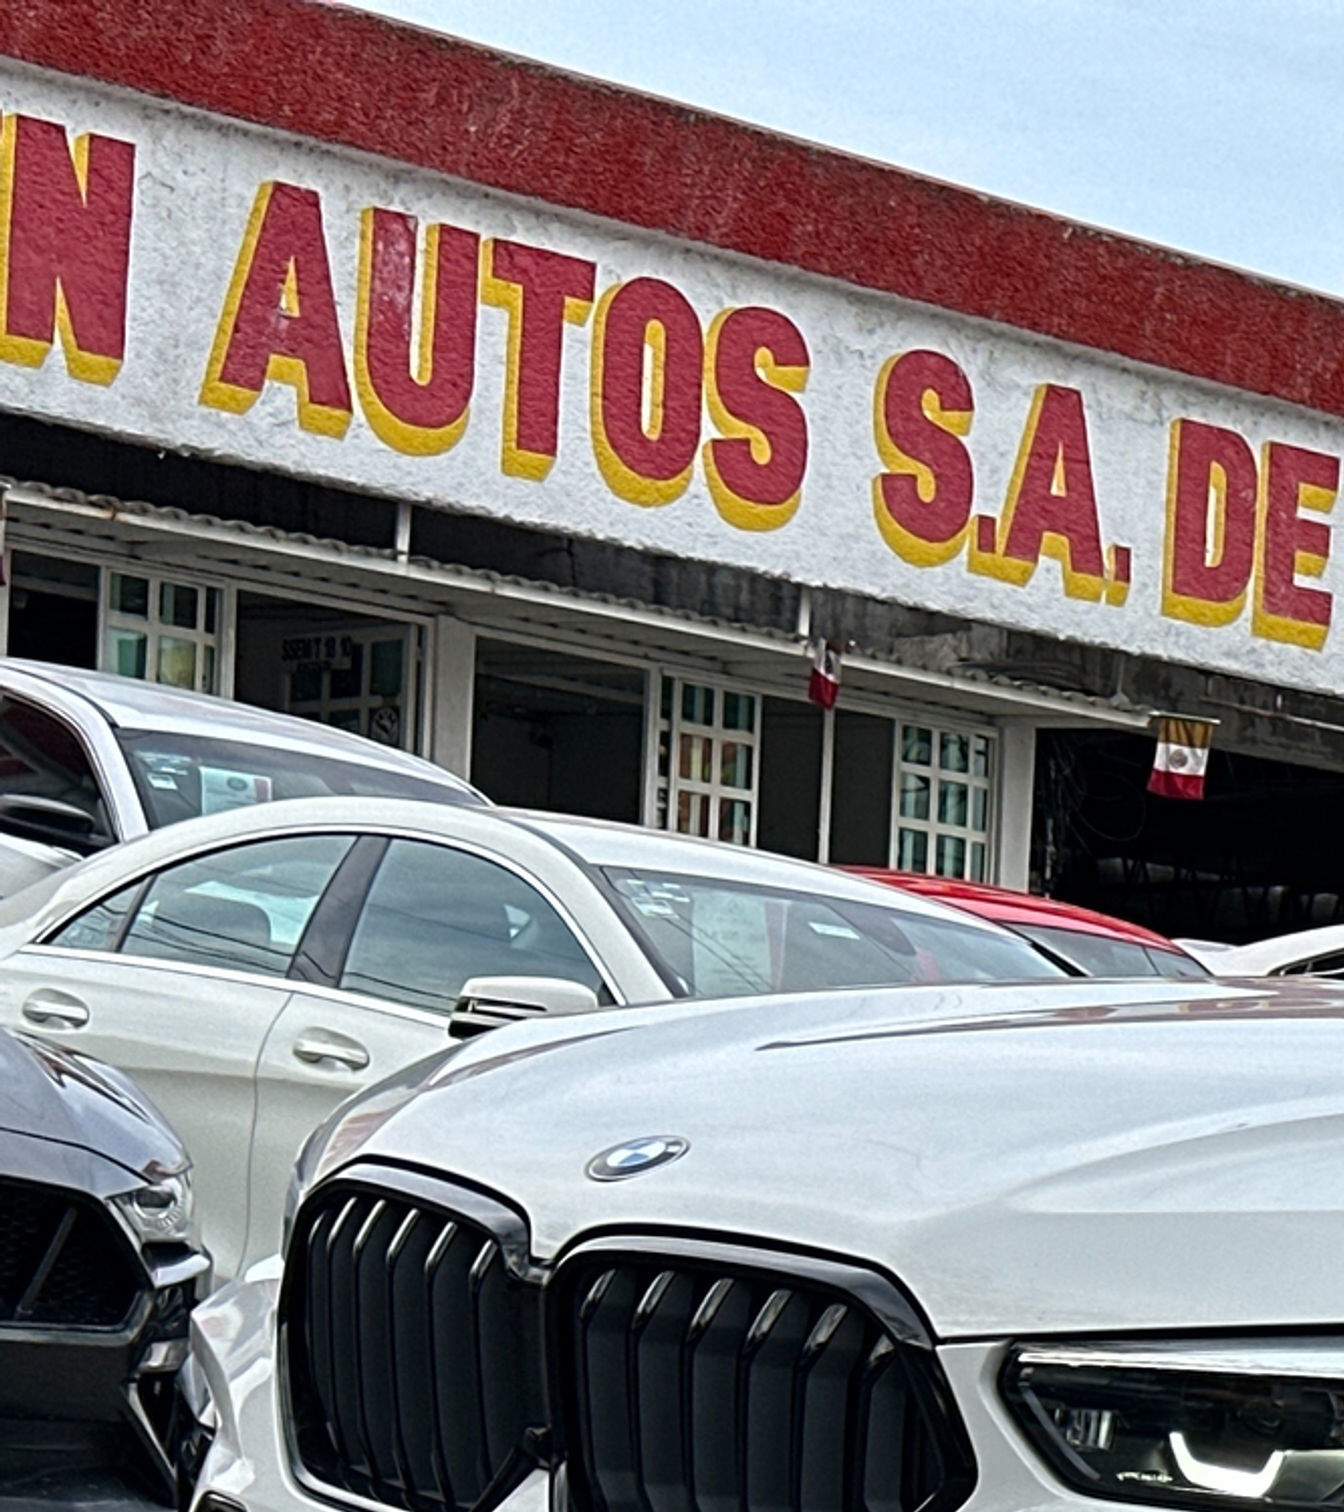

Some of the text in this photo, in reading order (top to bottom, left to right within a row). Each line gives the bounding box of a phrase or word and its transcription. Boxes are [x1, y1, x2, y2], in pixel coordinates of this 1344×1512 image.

[0, 110, 136, 388] N
[200, 181, 811, 531] AUTOS
[872, 348, 1131, 607] S.A.
[1161, 417, 1341, 651] DE
